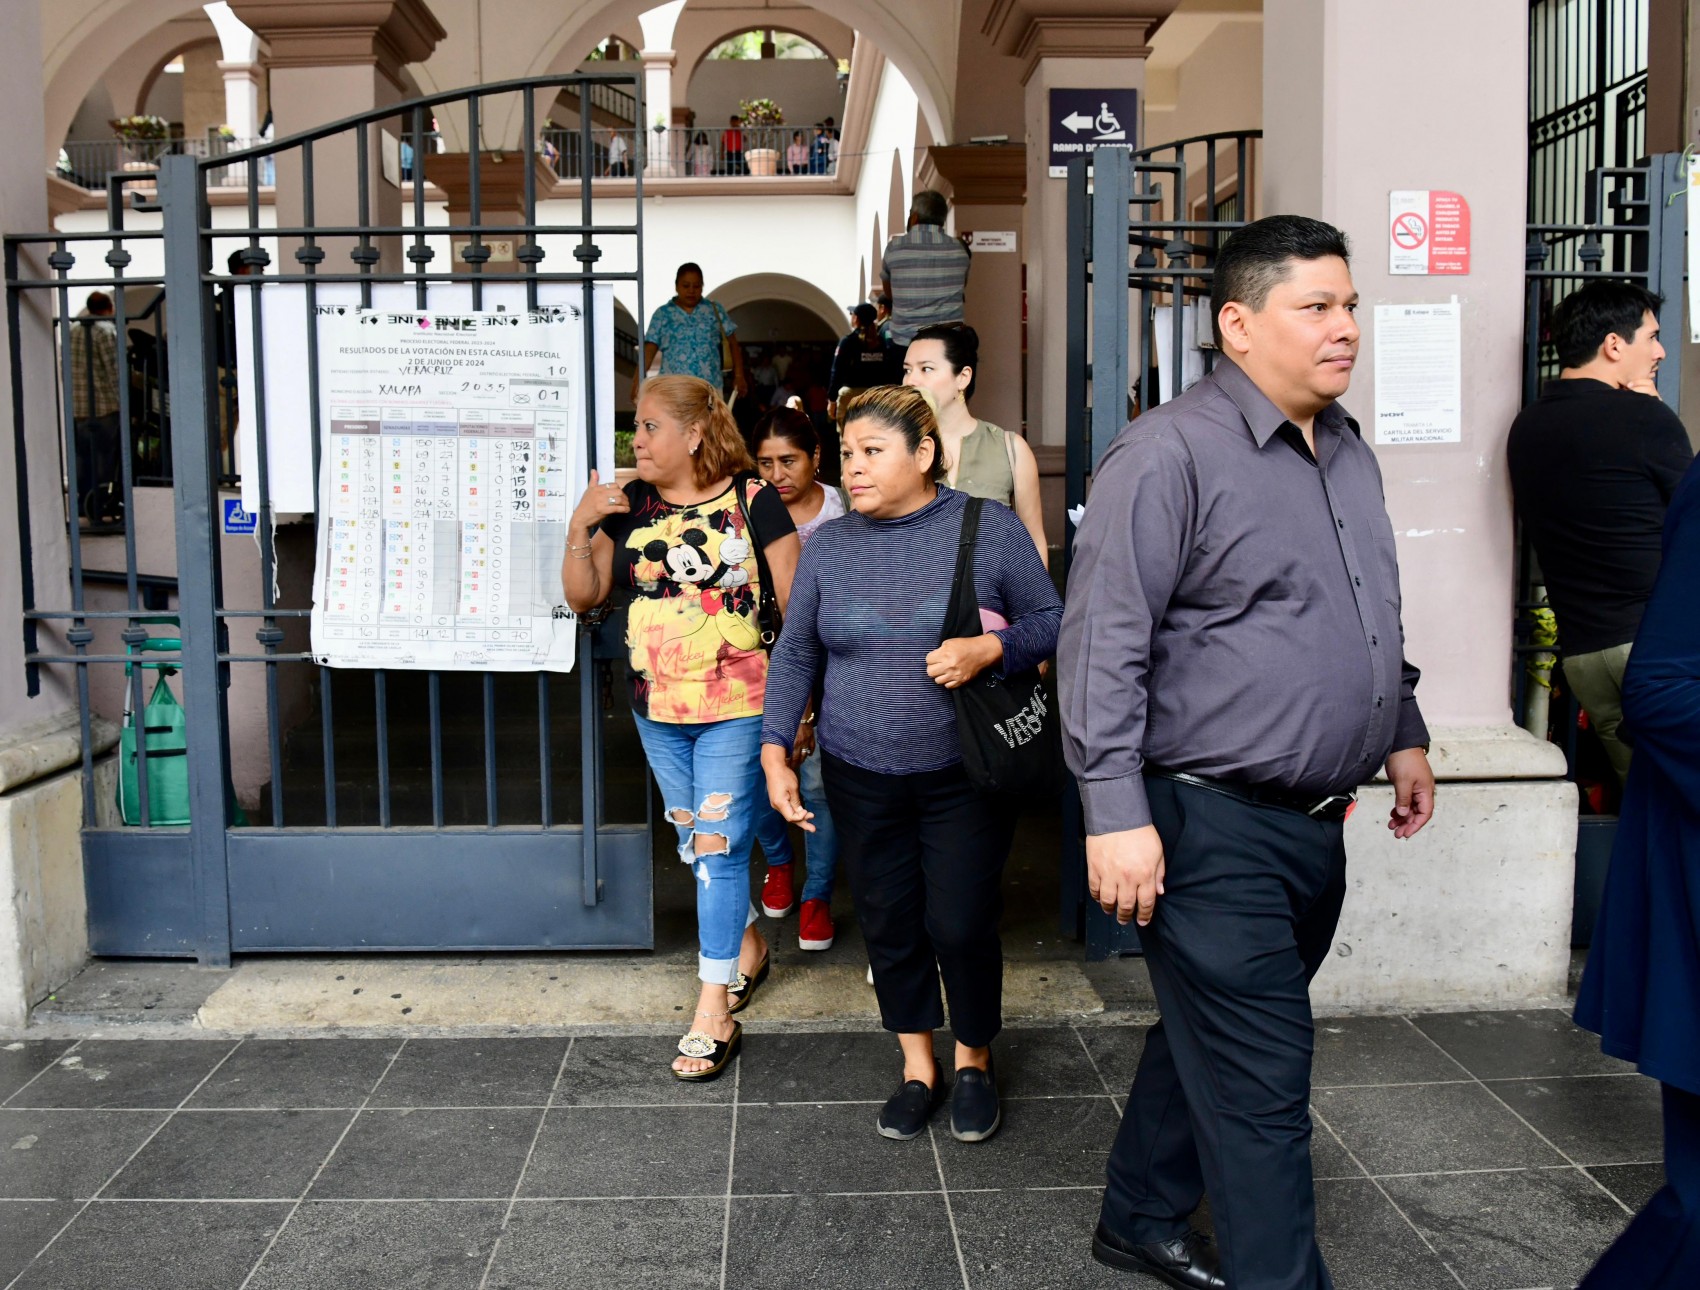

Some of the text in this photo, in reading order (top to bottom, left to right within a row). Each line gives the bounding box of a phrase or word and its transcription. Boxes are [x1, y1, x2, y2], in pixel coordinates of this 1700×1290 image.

[1052, 143, 1084, 152] RAMPA
[412, 347, 454, 356] VOTACIÓN
[524, 351, 561, 359] ESPECIAL
[398, 366, 454, 376] VERACRUZ
[379, 384, 421, 396] XALAPA
[658, 640, 705, 674] Mickey
[698, 682, 744, 719] Mickey
